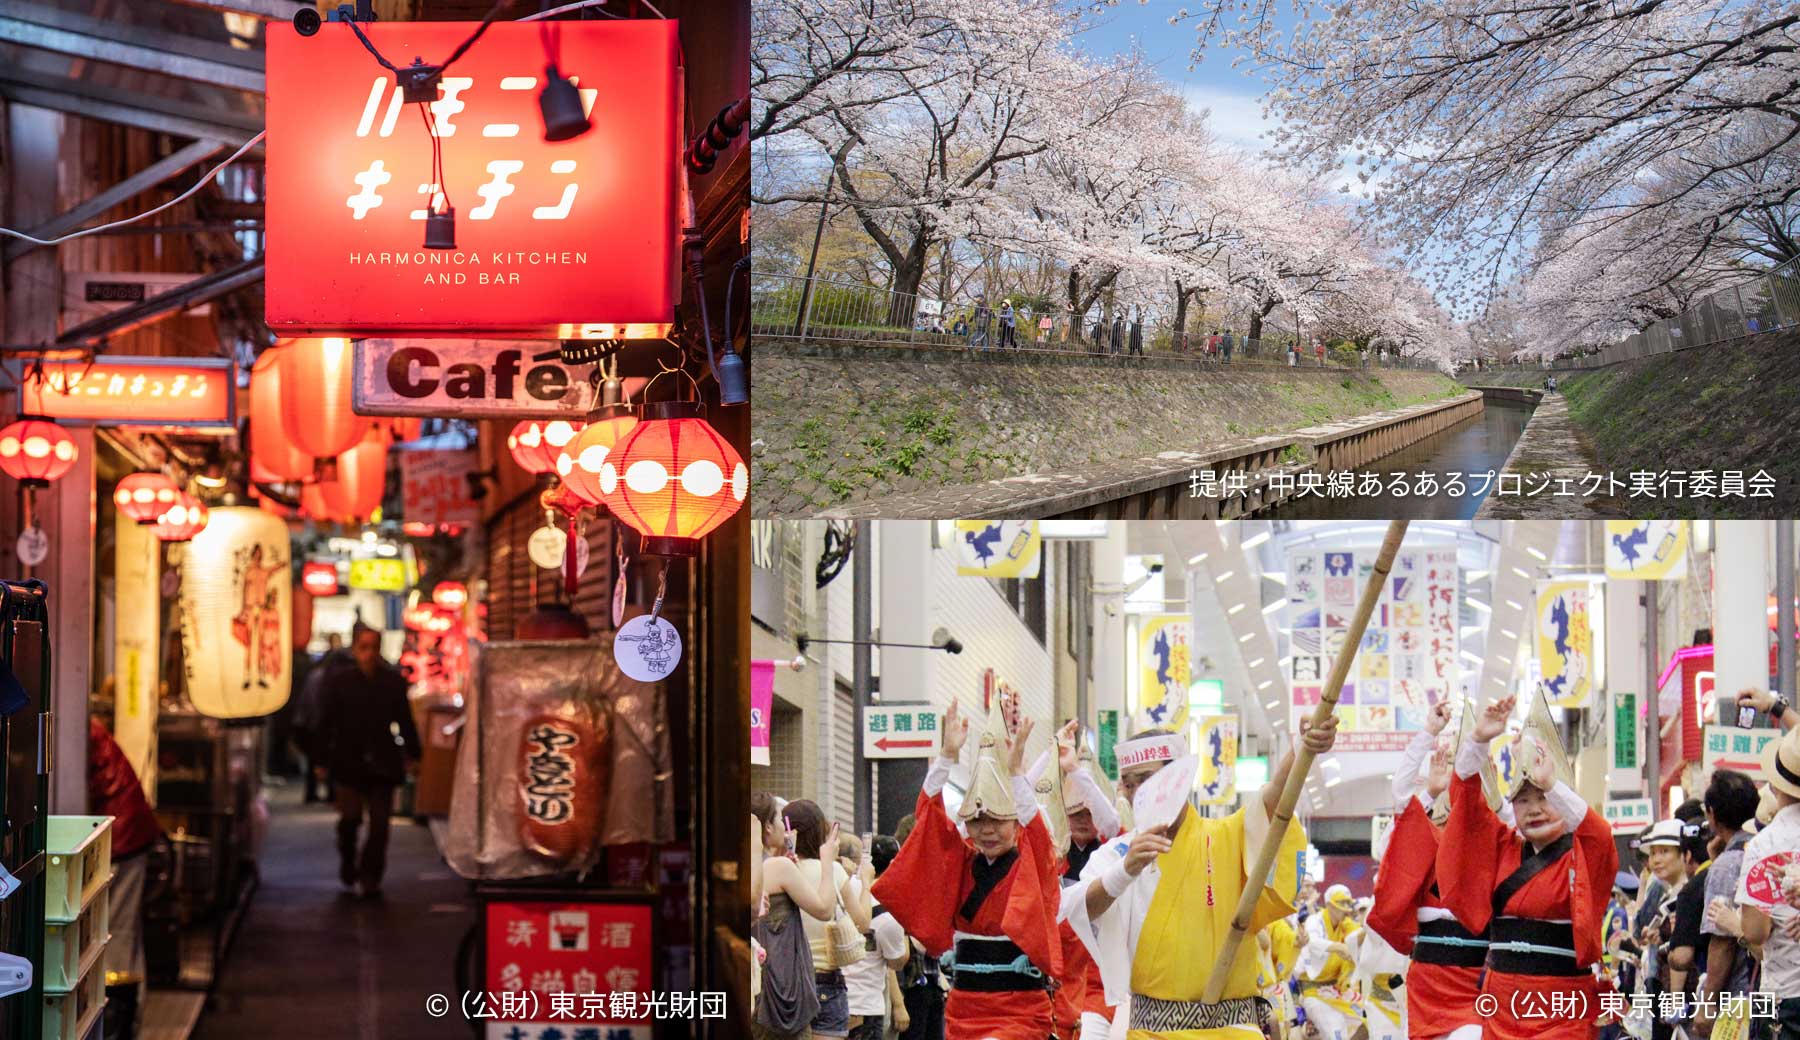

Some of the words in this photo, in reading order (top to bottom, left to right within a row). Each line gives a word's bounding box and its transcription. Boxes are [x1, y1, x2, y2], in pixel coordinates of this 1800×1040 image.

[346, 159, 580, 220] キッチン
[349, 252, 481, 265] HARMONICA
[492, 252, 588, 265] KITCHEN
[423, 272, 467, 285] AND
[478, 272, 521, 285] BAR
[386, 346, 570, 401] Café
[869, 712, 936, 732] 避難路
[601, 922, 635, 948] 酒
